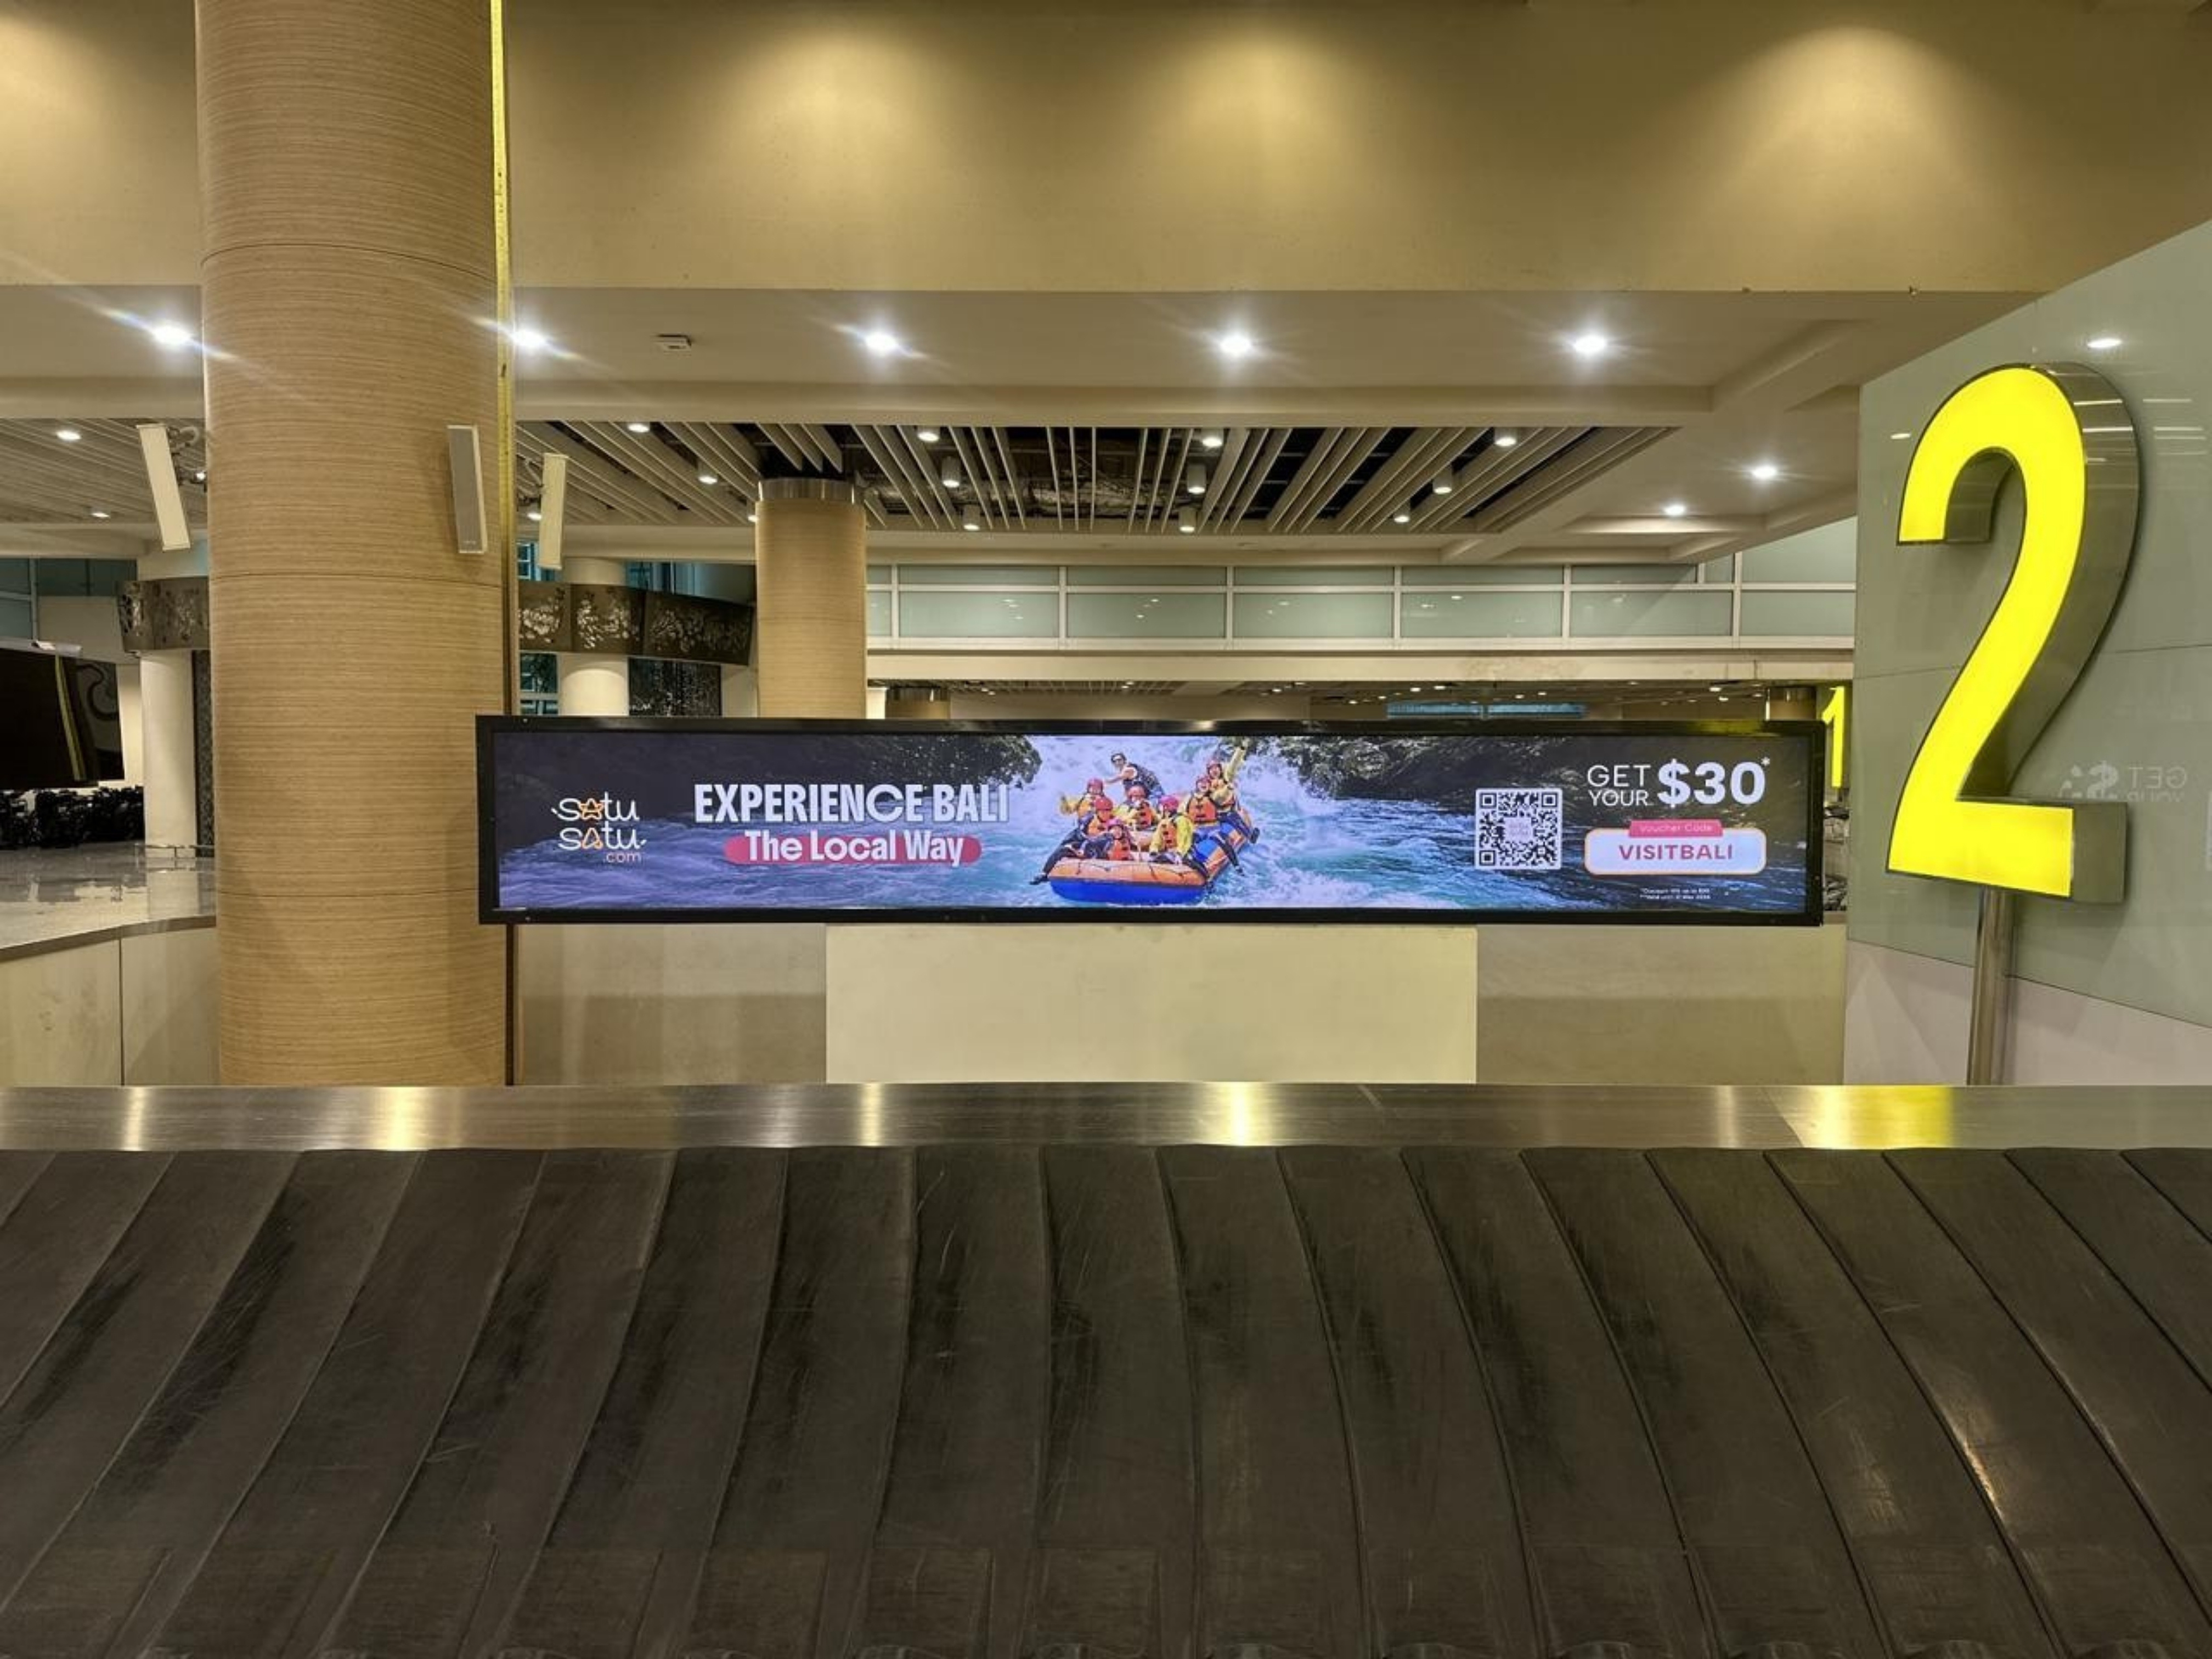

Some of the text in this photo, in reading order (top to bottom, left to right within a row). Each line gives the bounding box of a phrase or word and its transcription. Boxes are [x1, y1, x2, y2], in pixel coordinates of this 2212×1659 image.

[1887, 365, 2086, 899] 2
[1821, 685, 1845, 788] 1
[1587, 765, 1651, 787] GET
[694, 784, 1009, 823] EXPERIENCE BALI
[1588, 789, 1649, 806] YOUR
[1684, 822, 1712, 832] Code
[744, 830, 964, 867] The Local Way
[1618, 845, 1733, 860] VISITBALI
